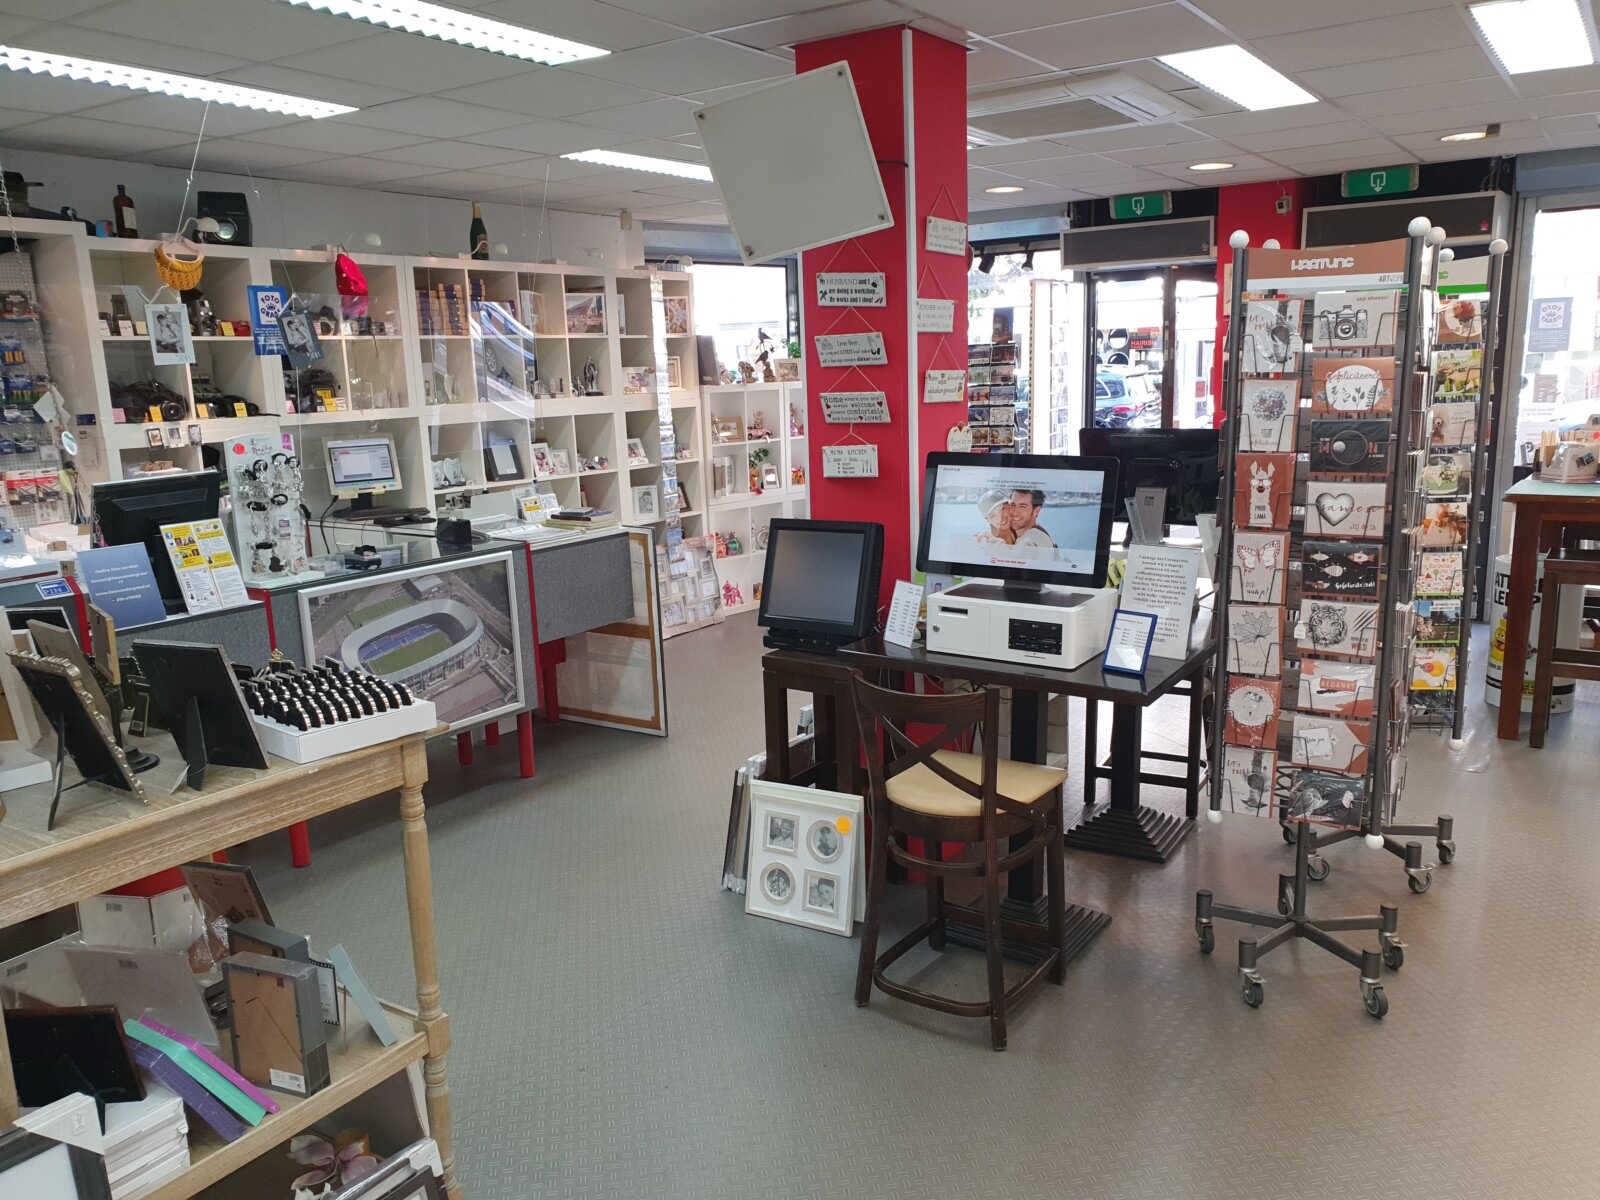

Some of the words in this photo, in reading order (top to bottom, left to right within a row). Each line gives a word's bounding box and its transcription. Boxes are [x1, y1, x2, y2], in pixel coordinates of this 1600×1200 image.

[826, 278, 858, 286] HUSBAND
[260, 295, 280, 304] FOTO
[1131, 339, 1157, 347] HAIRISH
[43, 587, 63, 596] PIN
[1321, 679, 1356, 689] BEDANKT
